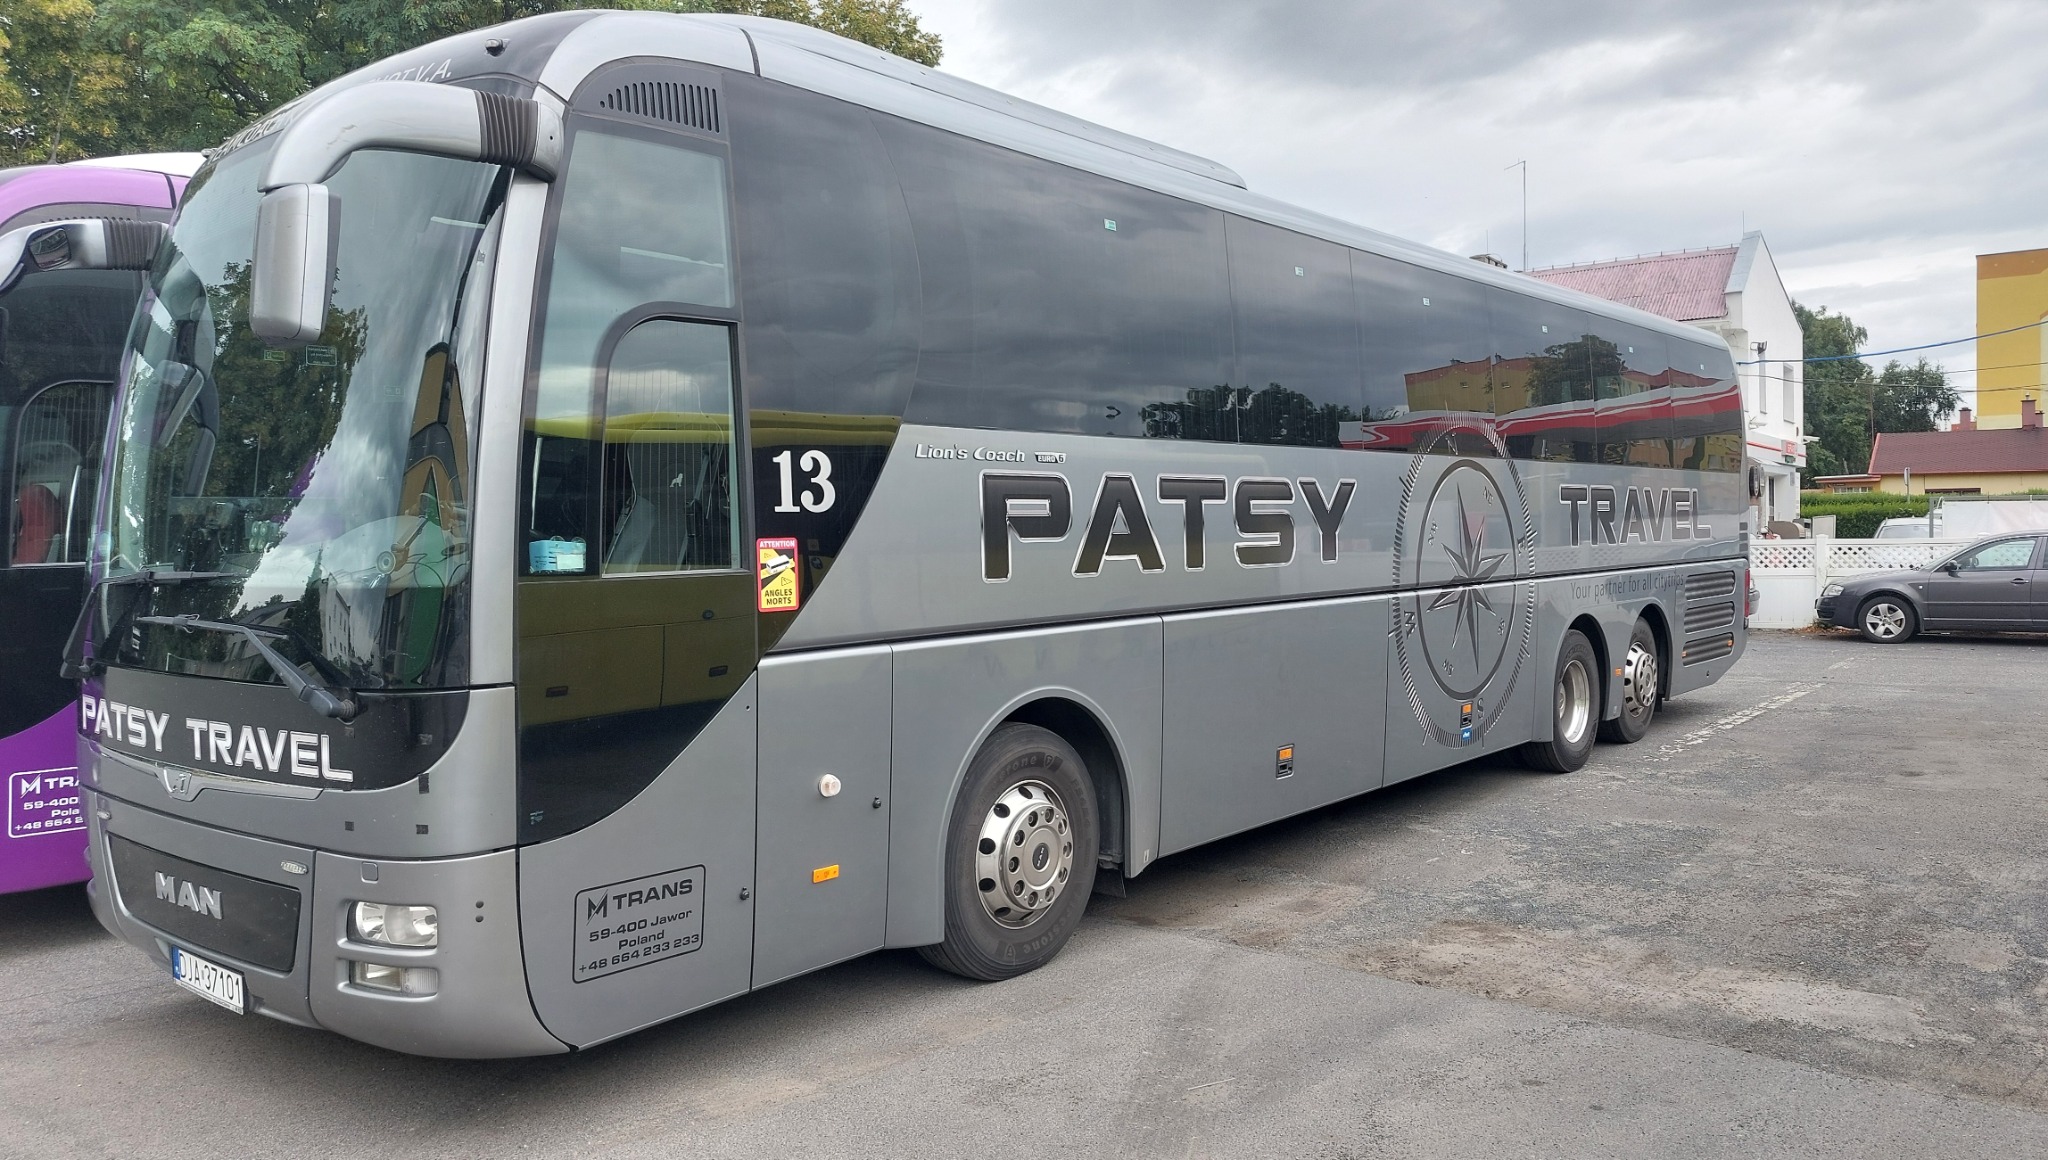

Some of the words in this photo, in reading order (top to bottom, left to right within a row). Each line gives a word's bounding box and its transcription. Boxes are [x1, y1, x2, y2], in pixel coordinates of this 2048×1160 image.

[915, 443, 968, 460] Lion's
[973, 446, 1025, 463] Coach
[1037, 455, 1056, 463] EURO
[1058, 453, 1066, 463] 6
[772, 449, 836, 513] 13
[979, 468, 1357, 584] PATSY
[1559, 484, 1712, 548] TRAVEL
[759, 540, 796, 548] ATTENTION
[764, 588, 793, 597] ANGLES
[766, 596, 792, 606] MORTS
[1570, 582, 1592, 600] Your
[1594, 579, 1626, 601] partner
[1628, 575, 1641, 592] for
[1642, 572, 1652, 590] all
[1654, 573, 1684, 591] citytrips
[81, 693, 170, 752] PATSY
[186, 717, 354, 783] TRAVEL
[23, 796, 79, 811] 59-400
[15, 821, 42, 831] +48
[44, 817, 72, 828] 664
[155, 871, 223, 920] MAN
[612, 878, 693, 910] TRANS
[589, 918, 648, 942] 59-400
[650, 909, 693, 927] Jawor
[618, 929, 665, 950] Poland
[578, 958, 608, 973] +48
[611, 949, 641, 965] 664
[643, 941, 671, 957] 233
[673, 933, 700, 949] 233
[179, 952, 202, 987] DJA
[204, 963, 241, 1005] 37101
